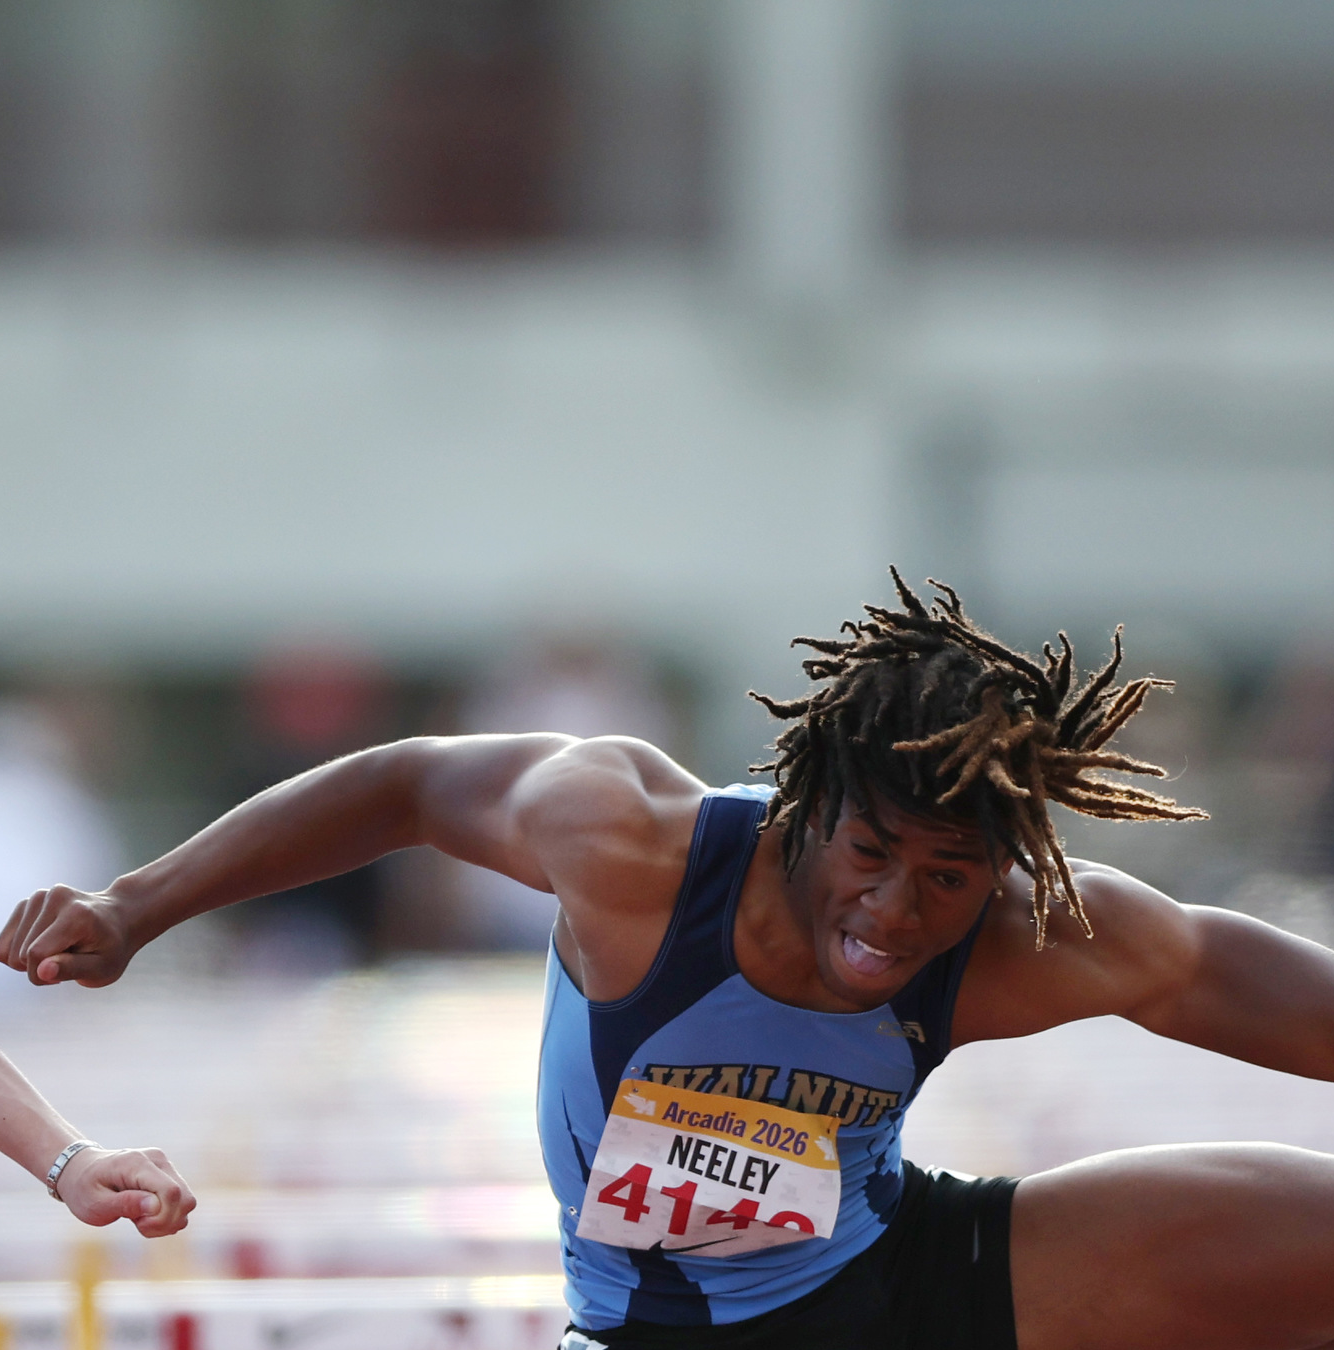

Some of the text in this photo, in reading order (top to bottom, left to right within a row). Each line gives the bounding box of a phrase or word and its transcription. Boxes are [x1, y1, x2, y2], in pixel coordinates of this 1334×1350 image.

[643, 1063, 902, 1128] WALNUT
[661, 1101, 810, 1156] Arcadia 2026
[666, 1134, 781, 1195] NEELEY
